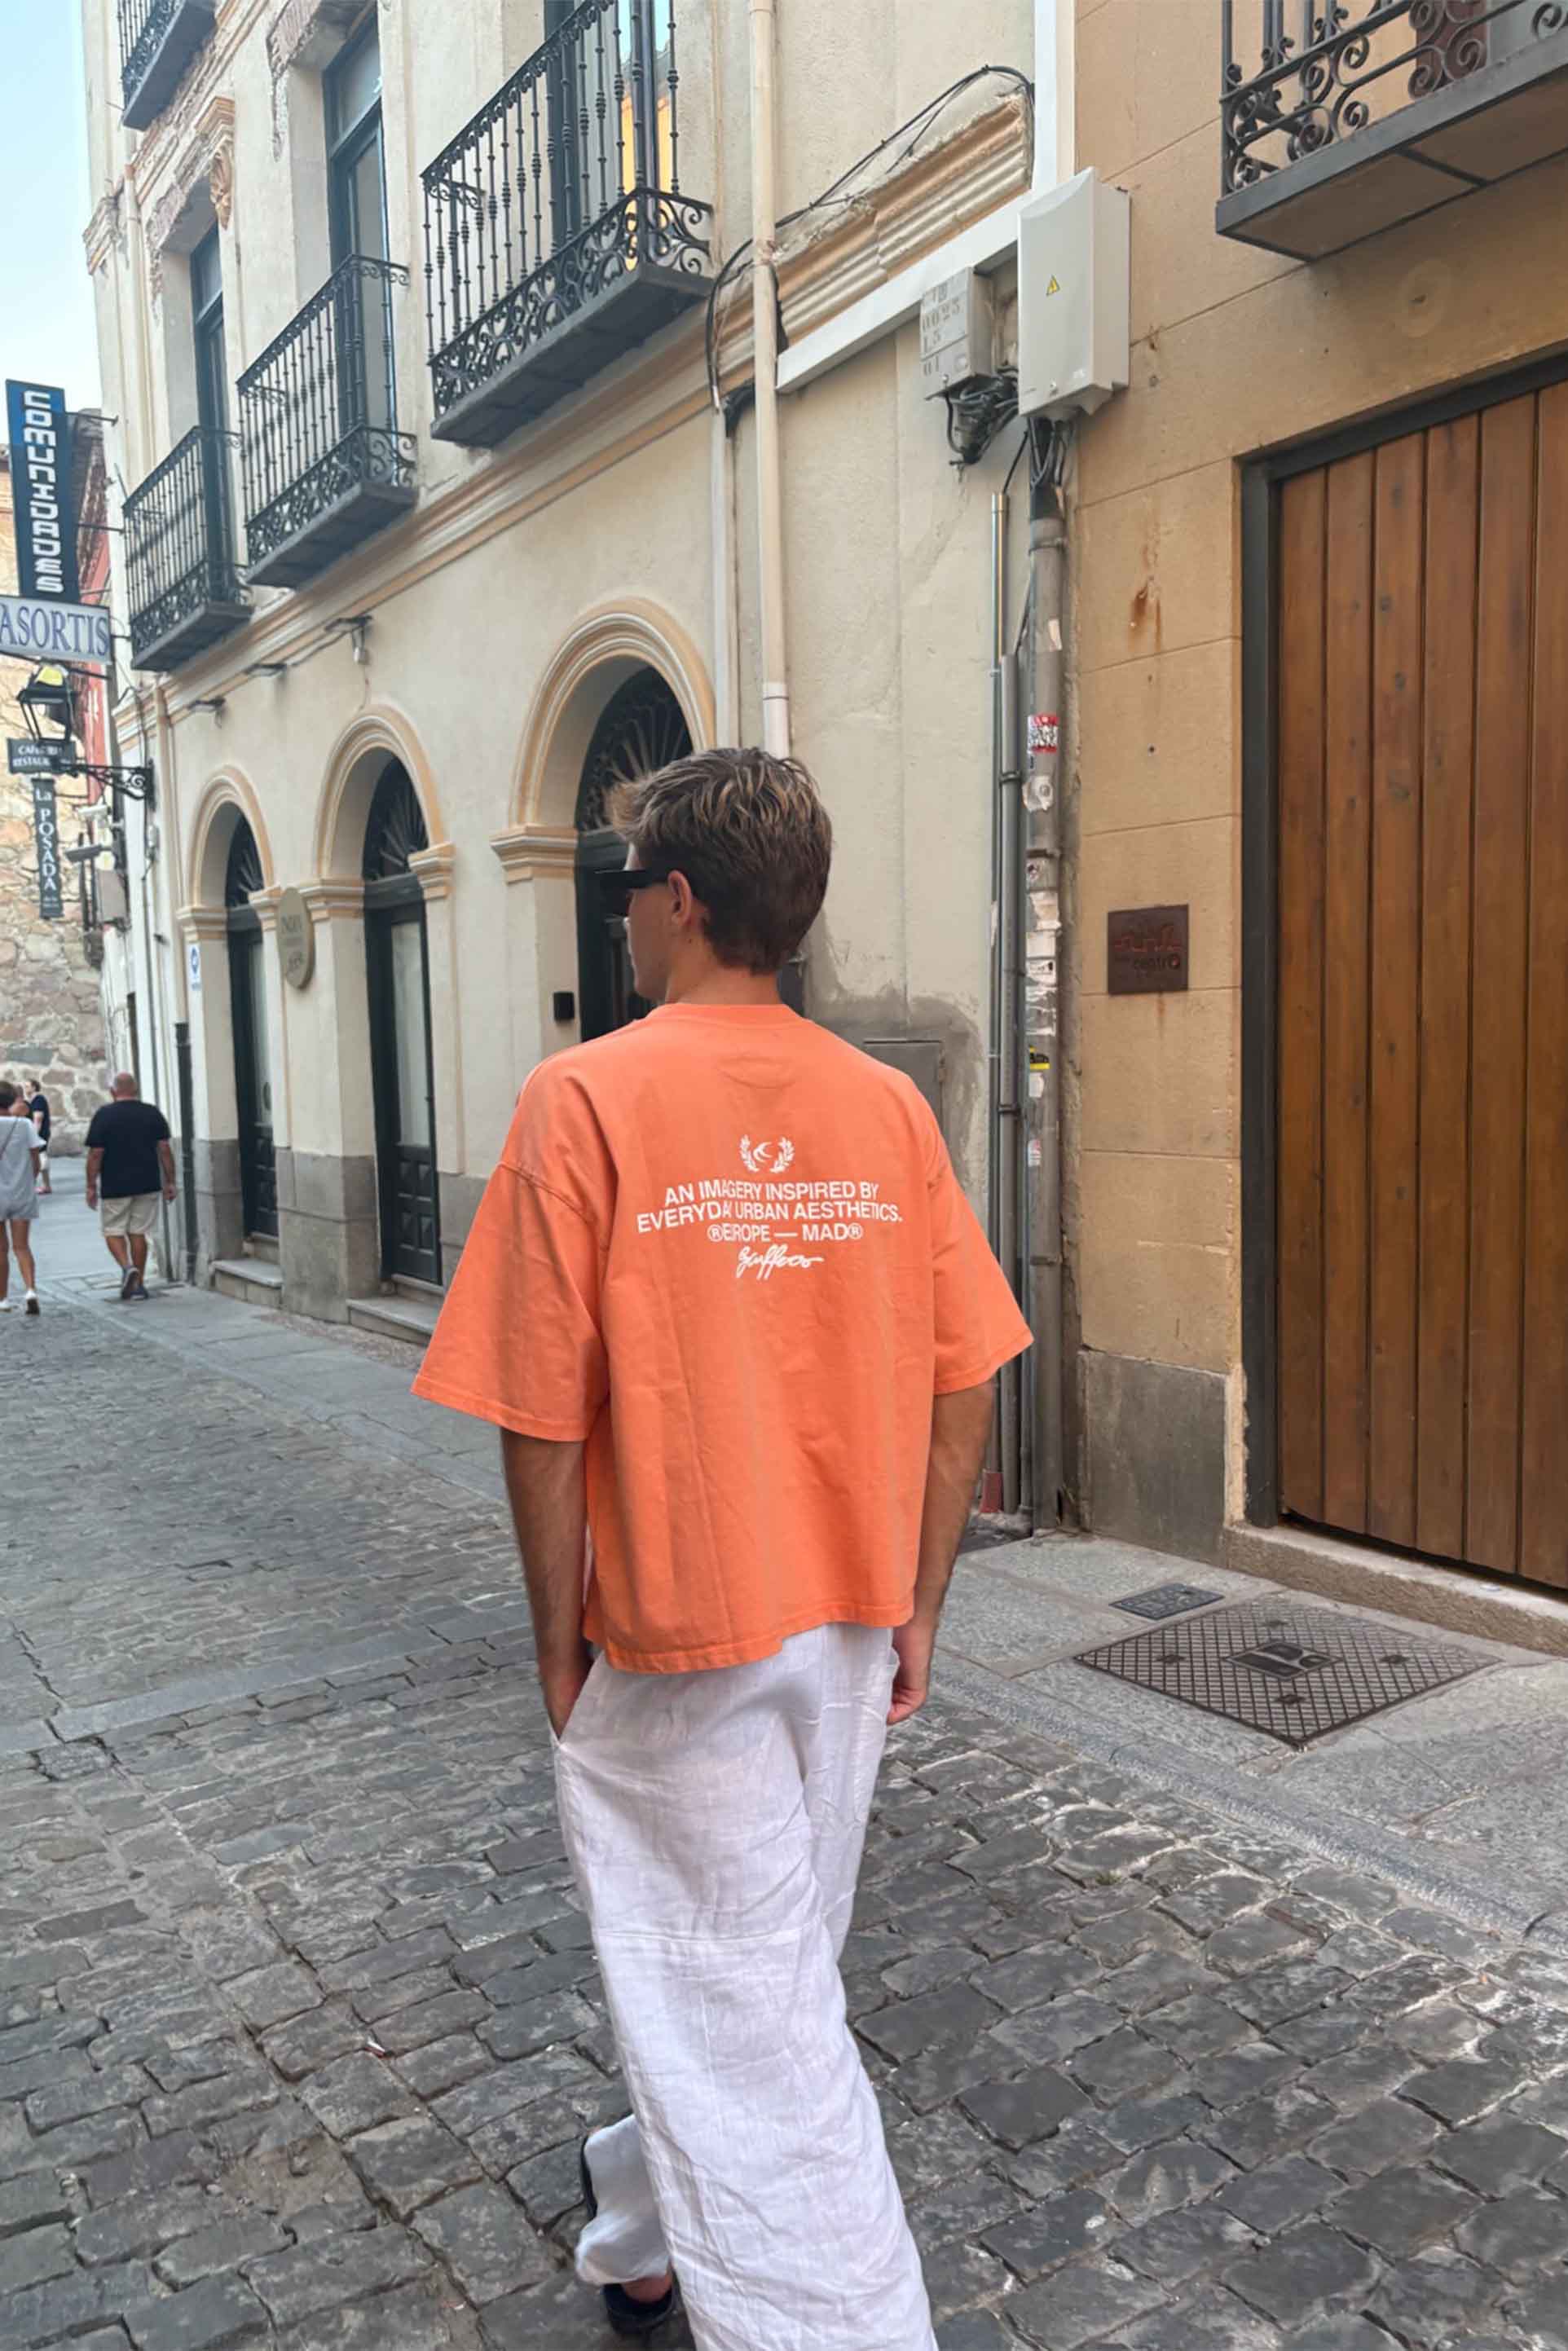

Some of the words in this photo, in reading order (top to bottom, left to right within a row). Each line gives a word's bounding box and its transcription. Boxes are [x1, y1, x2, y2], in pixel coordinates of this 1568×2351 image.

[24, 390, 64, 593] COMUNIDADES
[35, 788, 52, 801] La
[38, 808, 57, 891] POSADA
[665, 1183, 694, 1207] AN
[698, 1179, 762, 1200] IMAGERY
[766, 1181, 855, 1200] INSPIRED
[860, 1182, 879, 1200] BY
[735, 1201, 789, 1220] URBAN
[793, 1200, 903, 1222] AESTHETICS.
